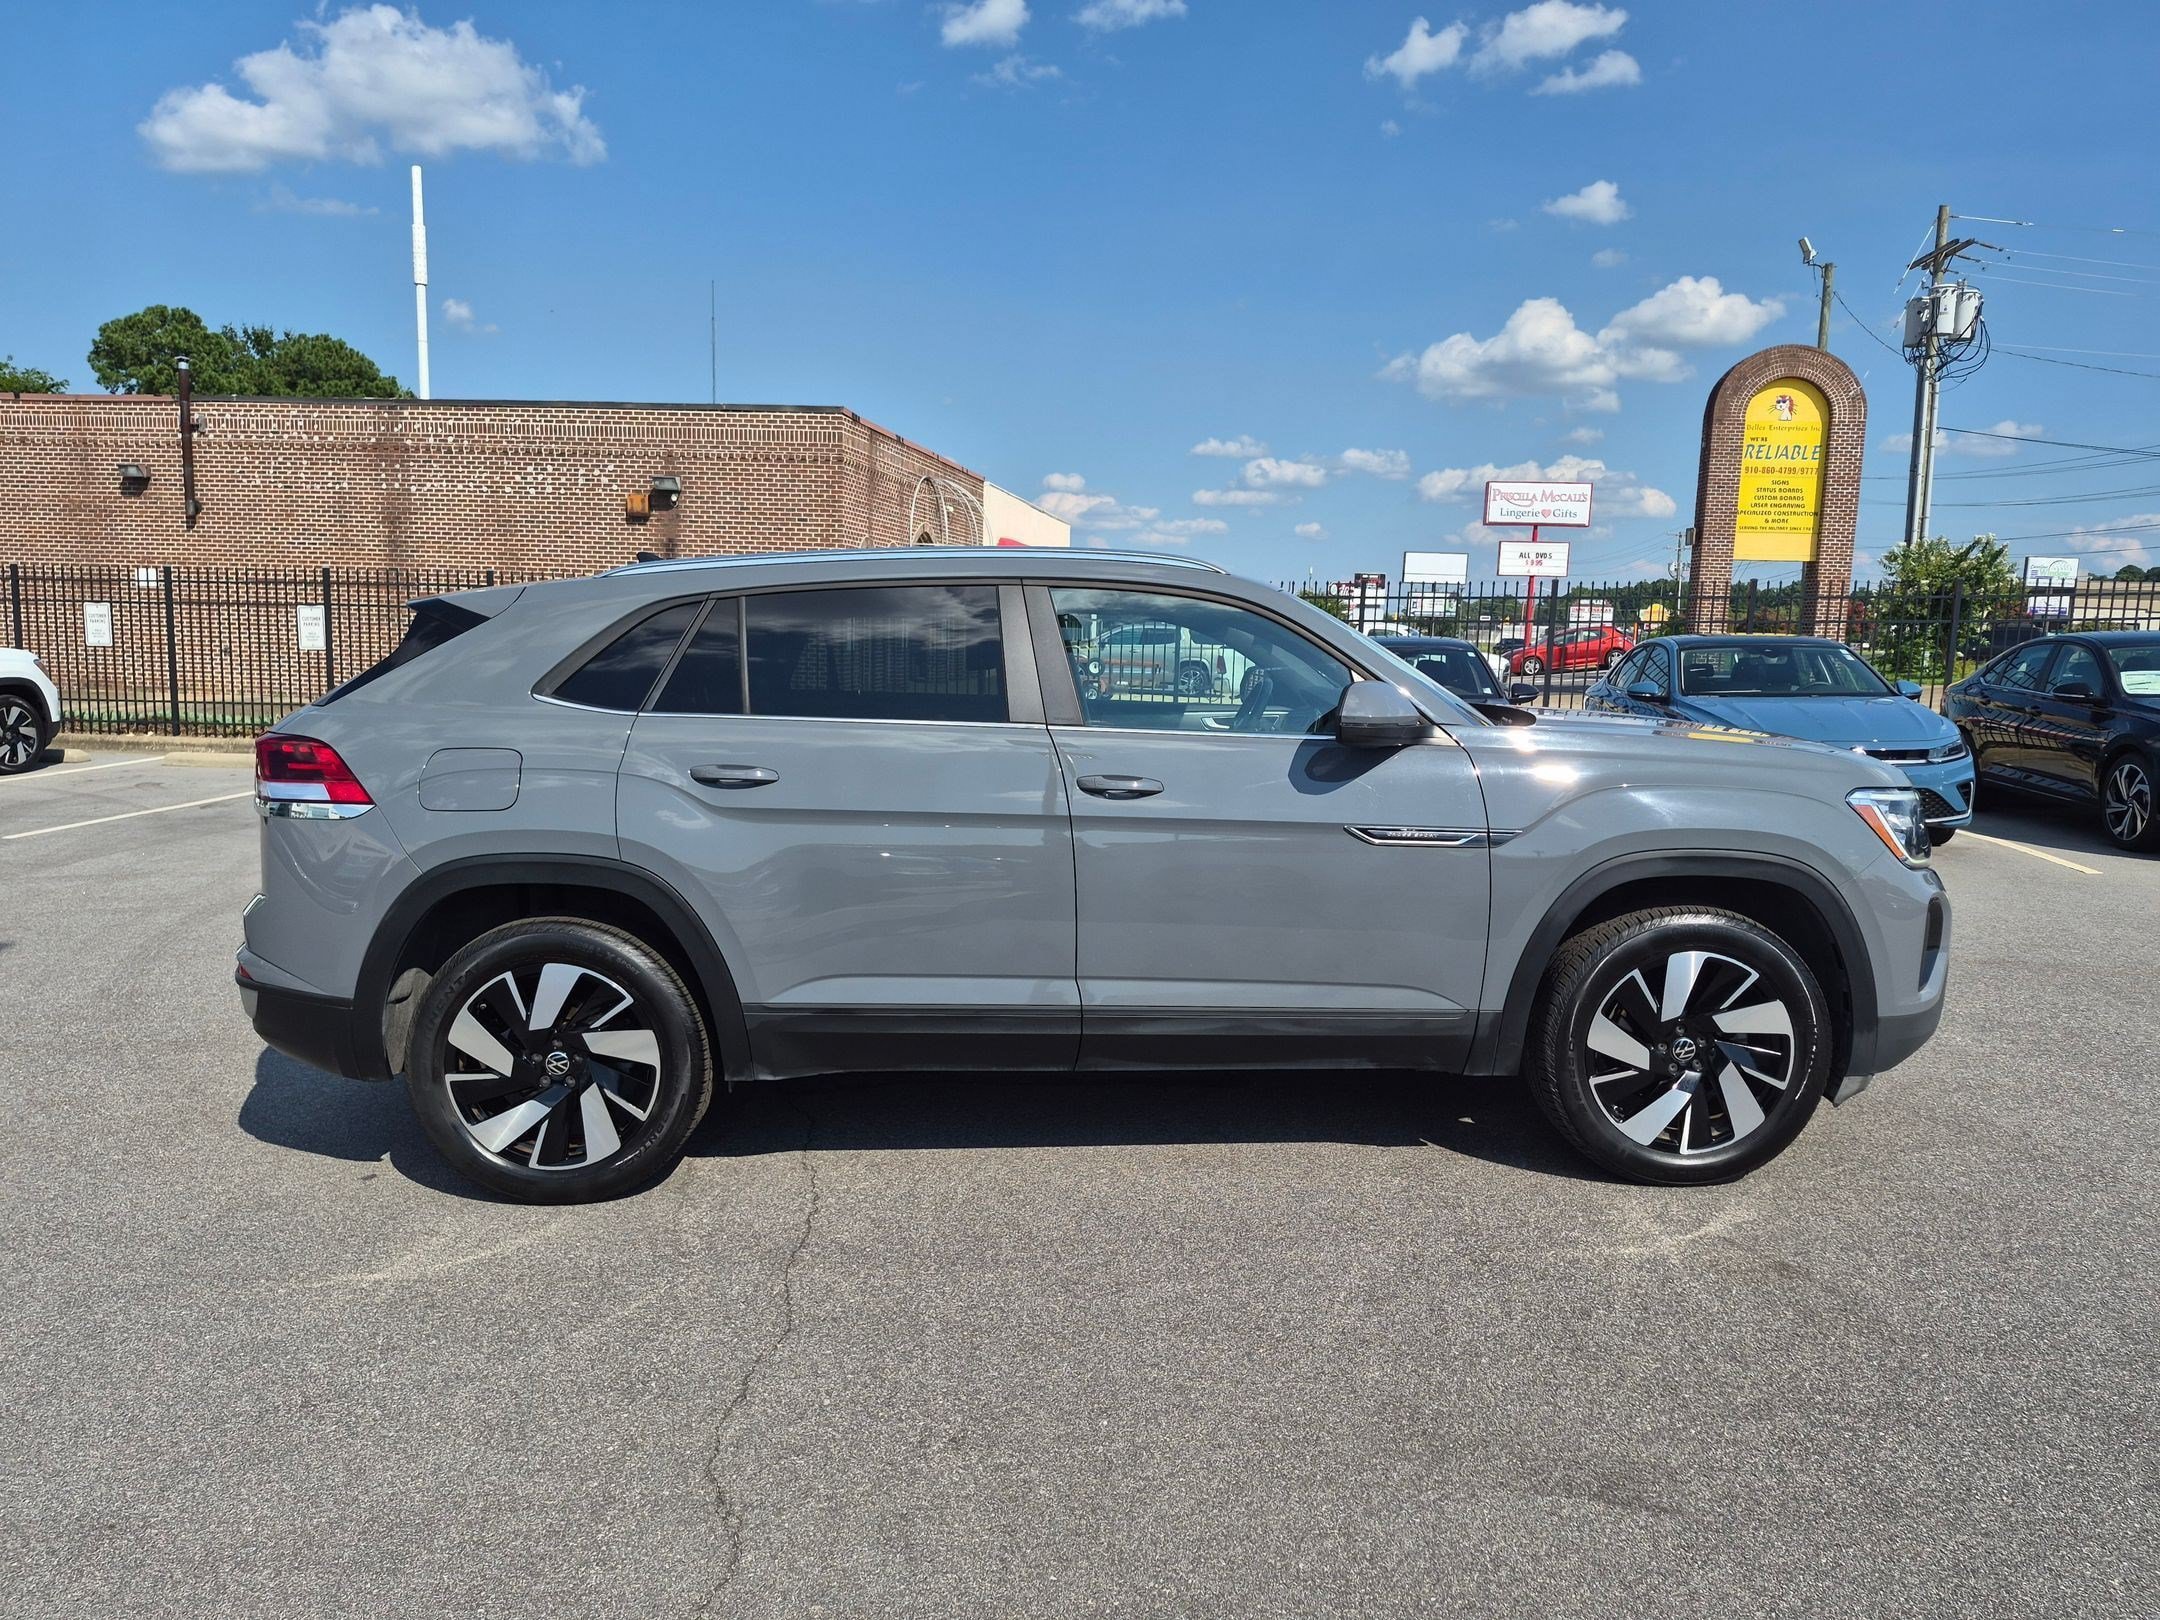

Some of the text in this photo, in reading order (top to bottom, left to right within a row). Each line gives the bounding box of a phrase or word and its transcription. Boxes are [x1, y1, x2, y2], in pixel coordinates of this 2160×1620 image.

[1744, 444, 1822, 460] RELIABLE
[1500, 507, 1578, 519] Lingerie Gifts
